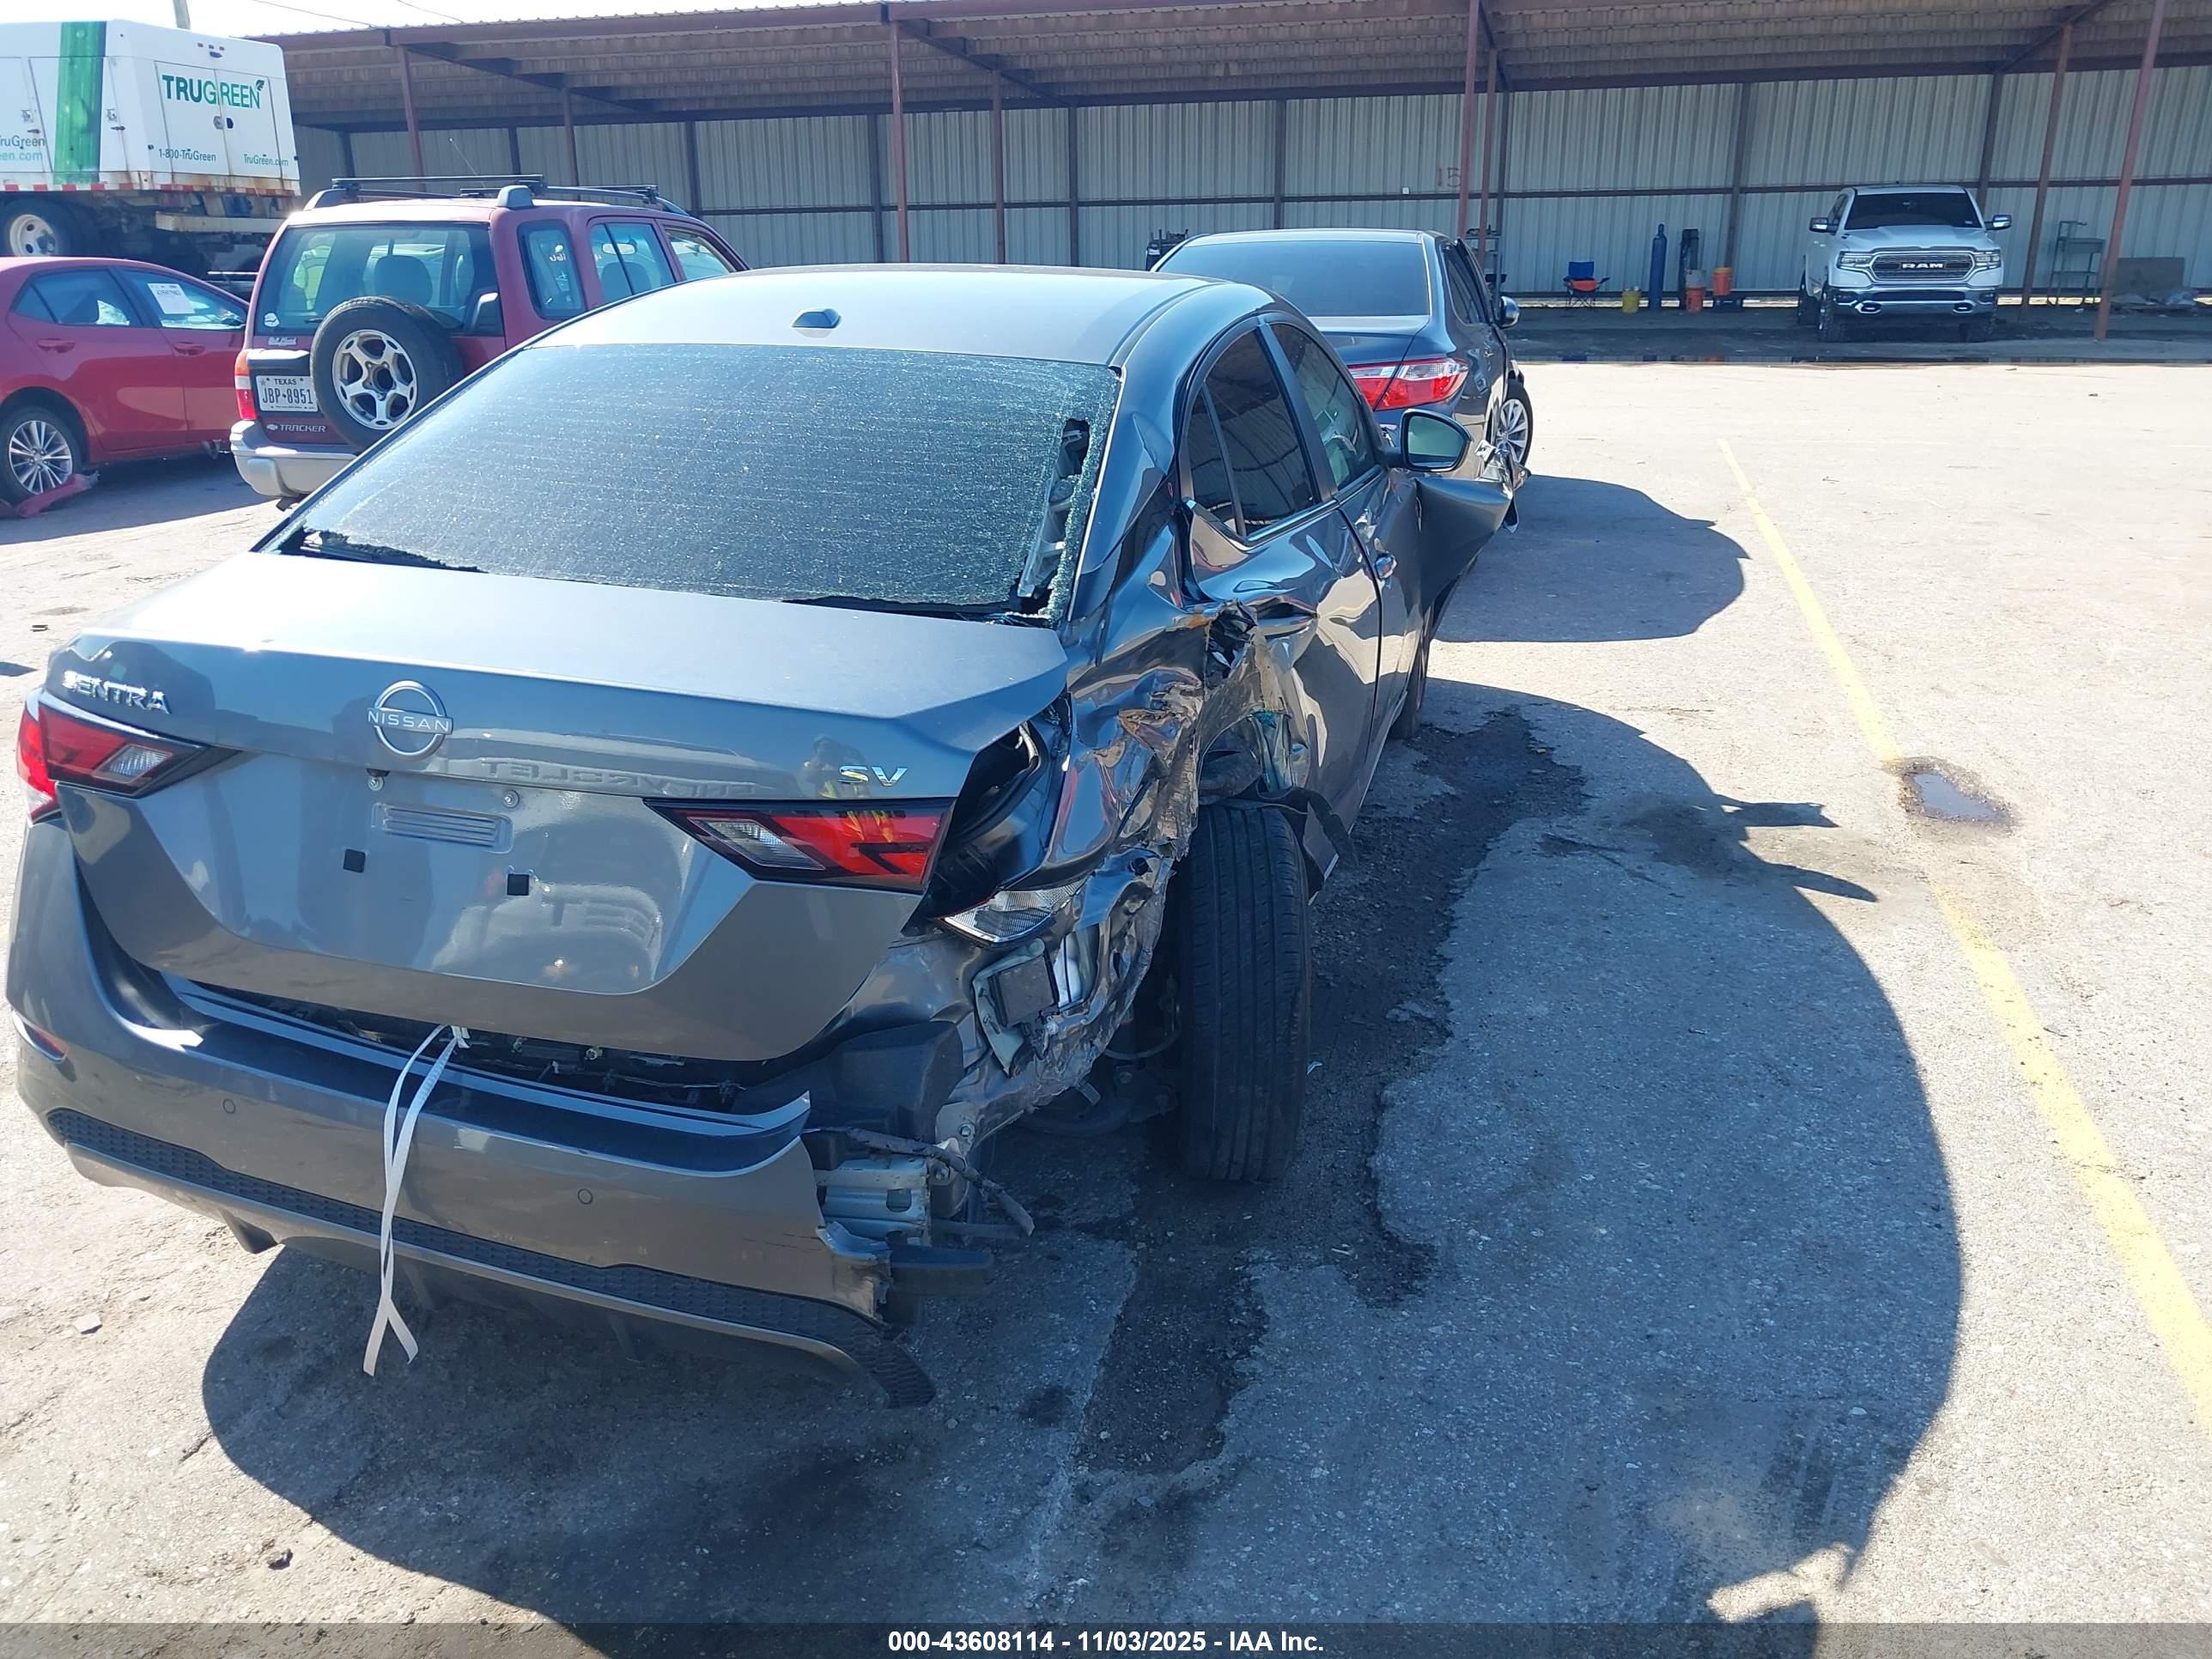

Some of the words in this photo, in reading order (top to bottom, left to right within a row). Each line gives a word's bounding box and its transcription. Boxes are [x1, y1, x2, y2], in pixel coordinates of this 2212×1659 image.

[161, 74, 260, 109] TRUGREEN
[0, 134, 46, 147] ruGreen
[158, 148, 216, 161] 1-800-TruGreen
[243, 154, 289, 167] TruGreen.com
[280, 424, 326, 433] TRACKER
[62, 670, 171, 714] SENTRA
[367, 710, 449, 732] NISSAN
[837, 765, 908, 787] SV
